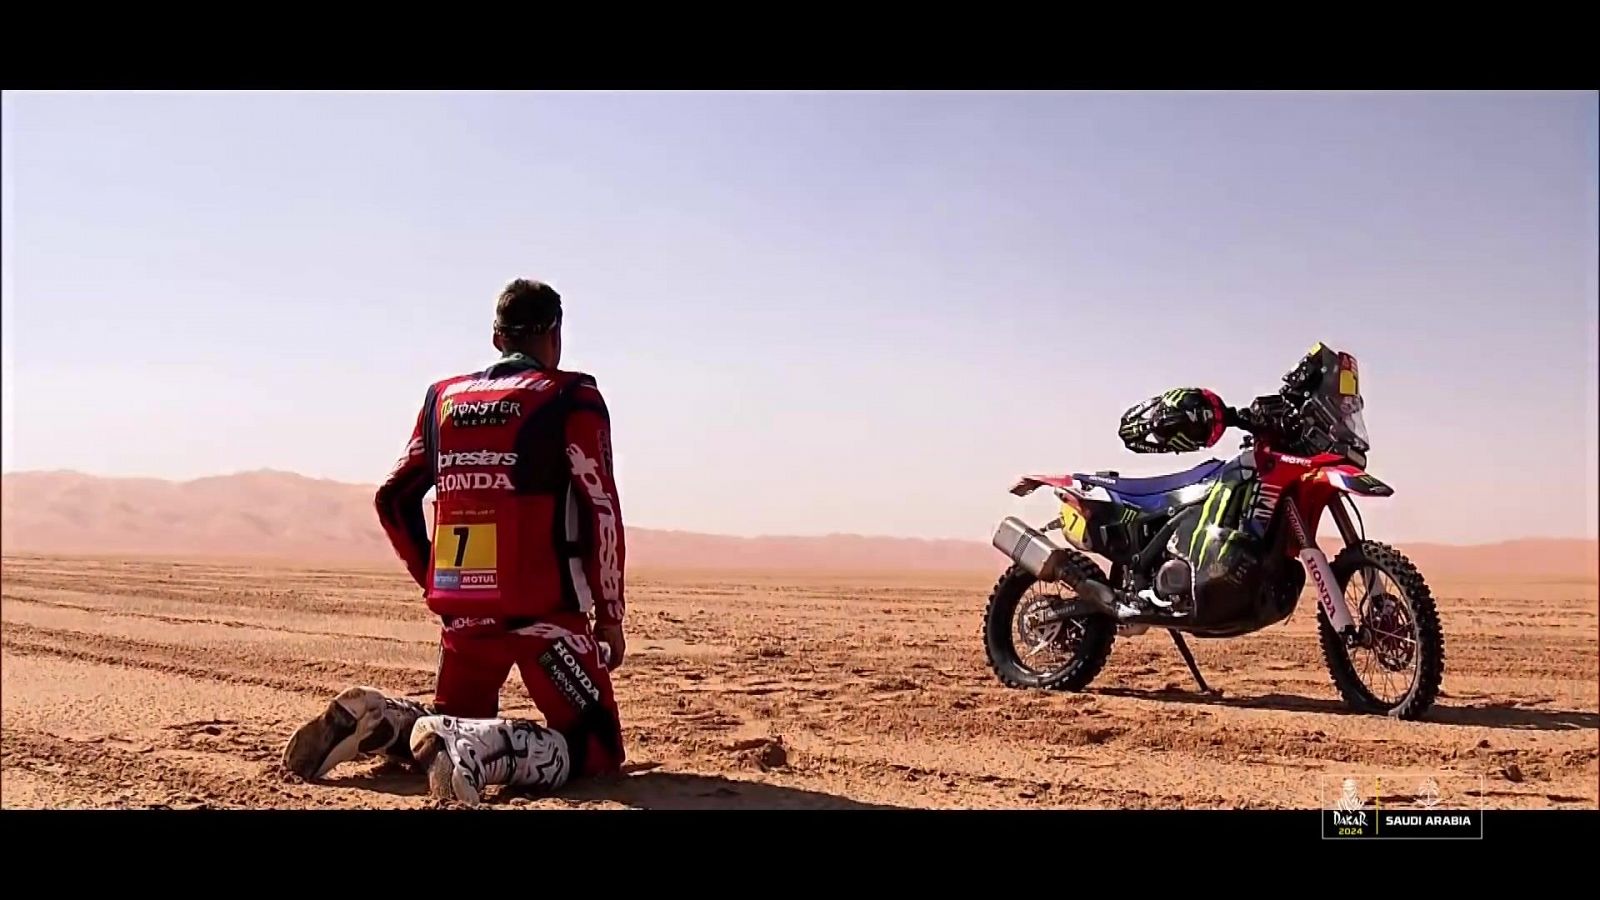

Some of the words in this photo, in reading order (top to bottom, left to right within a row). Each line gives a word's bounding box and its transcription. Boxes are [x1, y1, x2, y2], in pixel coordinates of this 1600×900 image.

[453, 527, 470, 567] 7
[462, 573, 495, 583] MOTUL
[1307, 556, 1337, 619] HONDA
[552, 642, 600, 701] HONDA
